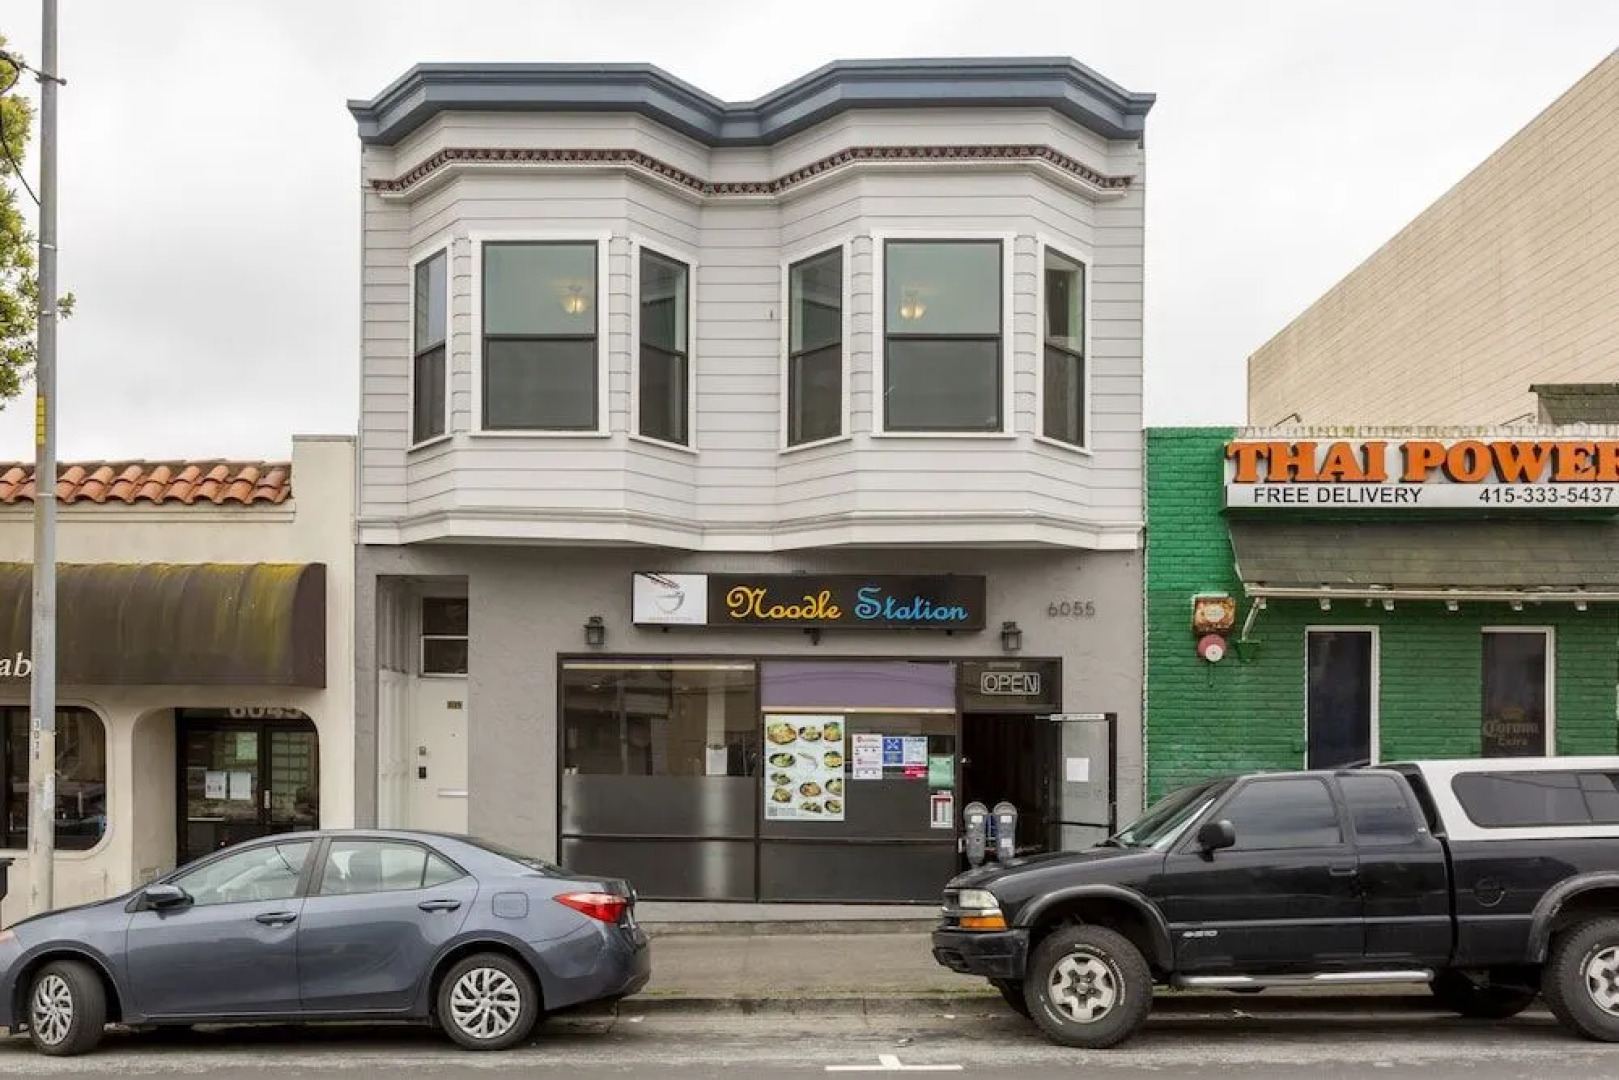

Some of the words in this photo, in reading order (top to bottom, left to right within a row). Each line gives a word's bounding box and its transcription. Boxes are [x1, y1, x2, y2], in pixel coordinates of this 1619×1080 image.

[1227, 440, 1387, 483] THAI
[1253, 487, 1309, 503] FREE
[1316, 487, 1423, 504] DELIVERY
[1479, 486, 1614, 504] 415-333-5437
[726, 585, 842, 620] Noodle
[854, 586, 967, 621] Station
[1048, 601, 1096, 618] 6055
[984, 674, 1038, 692] OPEN
